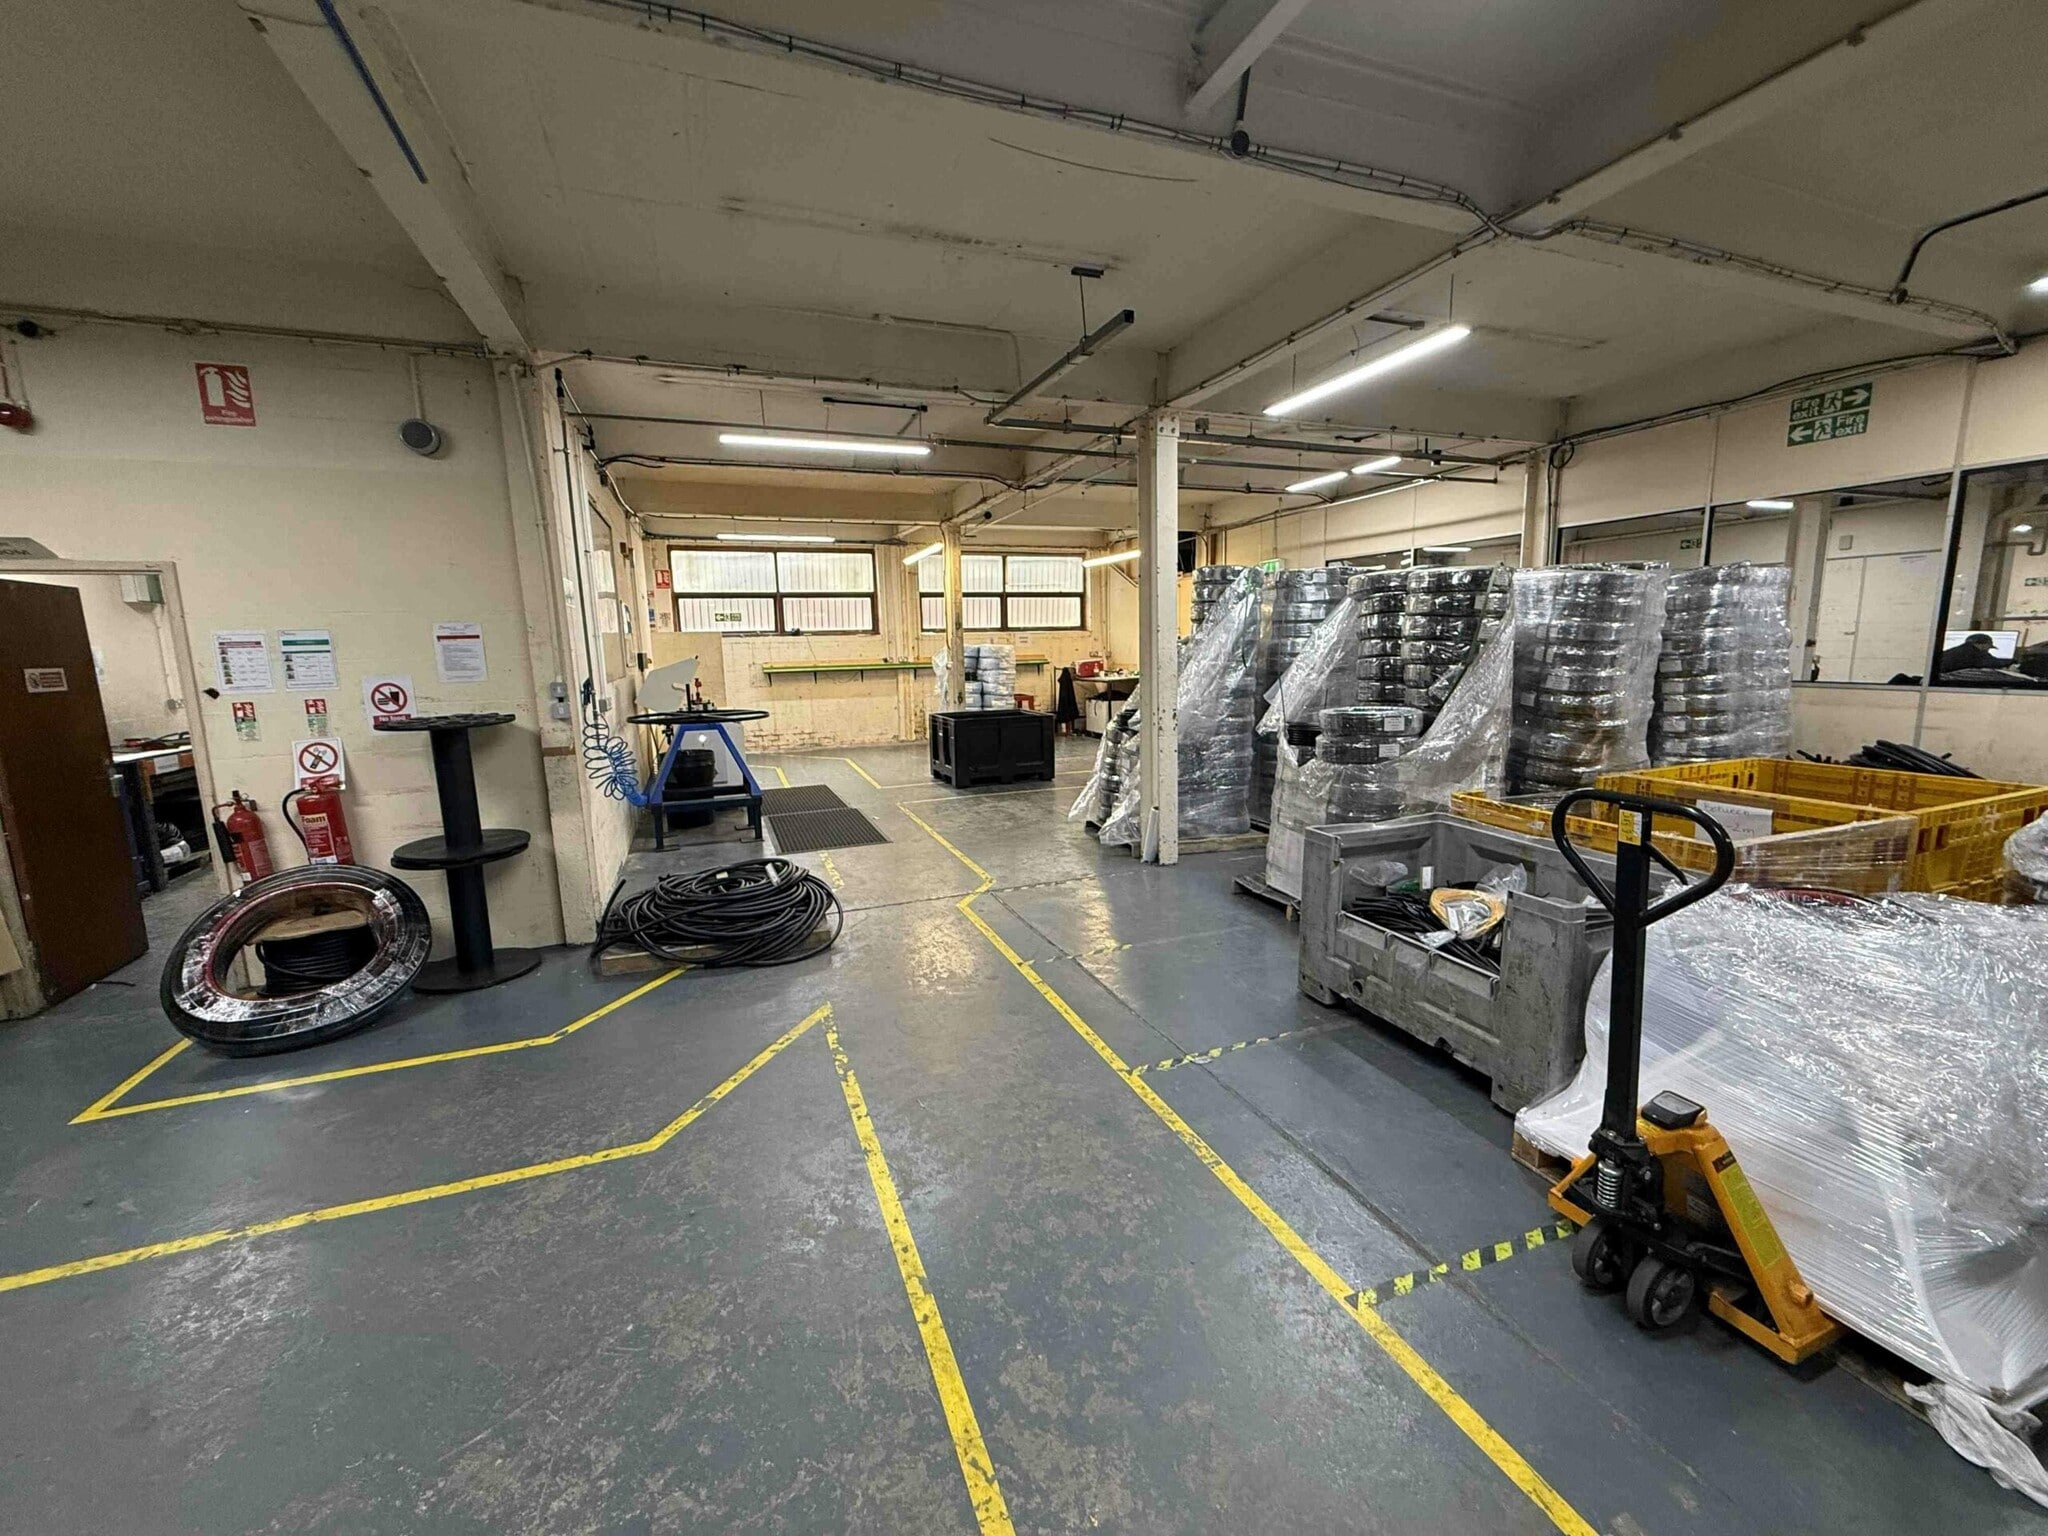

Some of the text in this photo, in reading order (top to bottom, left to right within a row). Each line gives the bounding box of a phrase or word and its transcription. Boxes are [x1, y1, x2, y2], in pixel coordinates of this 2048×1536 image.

[1794, 398, 1820, 411] Fire
[1792, 406, 1819, 420] exit
[1836, 414, 1865, 427] Fire
[1835, 423, 1865, 437] exit
